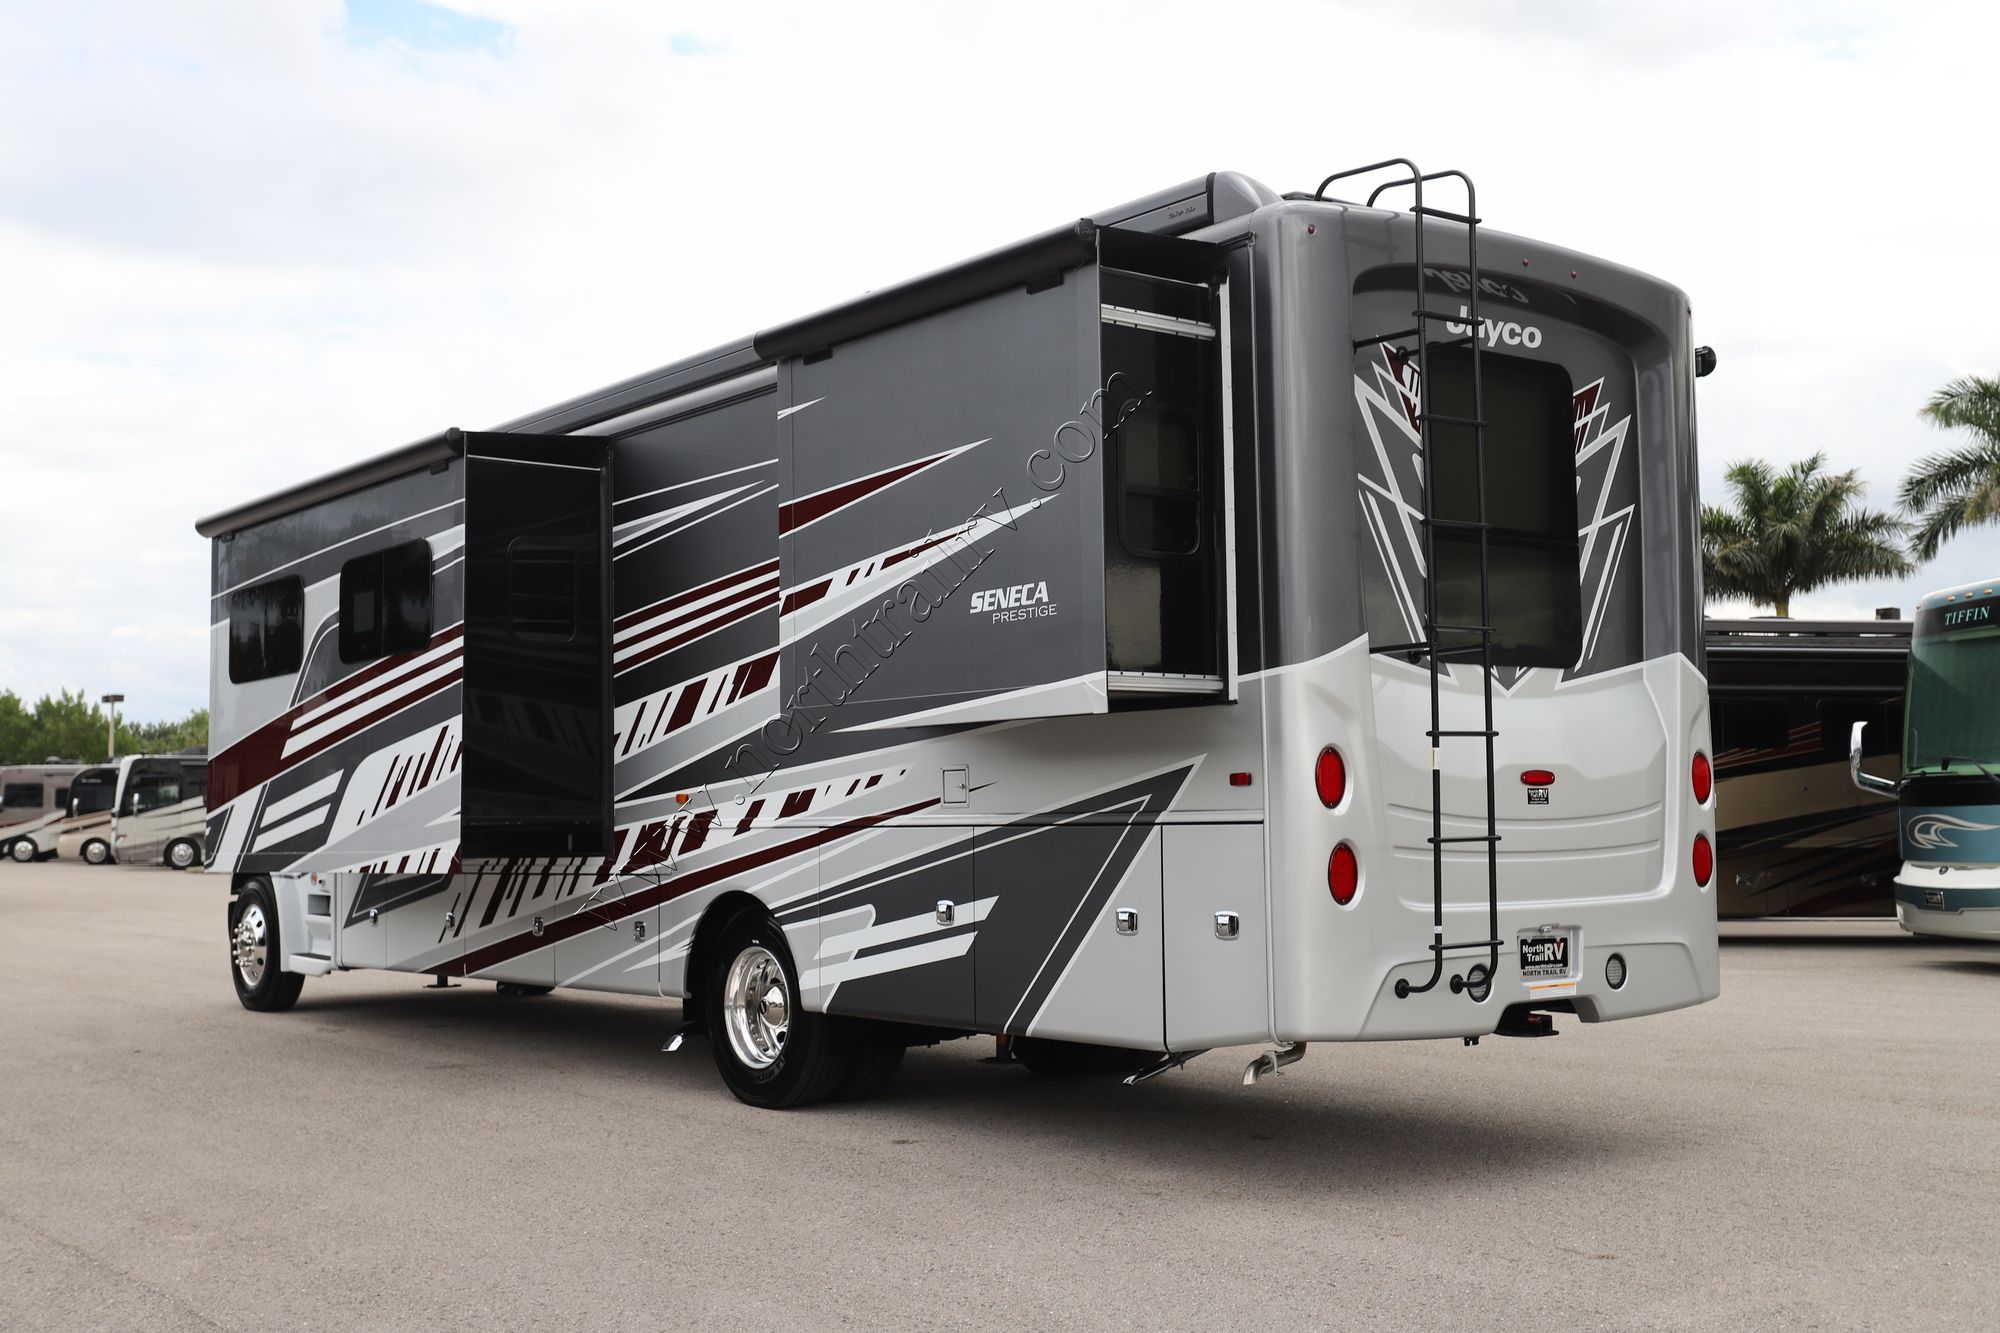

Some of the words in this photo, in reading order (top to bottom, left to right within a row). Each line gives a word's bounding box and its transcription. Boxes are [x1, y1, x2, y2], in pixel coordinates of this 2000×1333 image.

[970, 581, 1049, 614] SENECA
[992, 603, 1058, 624] PRESTIGE
[1945, 606, 1990, 625] TIFFIN
[1523, 945, 1544, 954] North
[1526, 953, 1544, 962] Trail
[1545, 943, 1564, 960] RV
